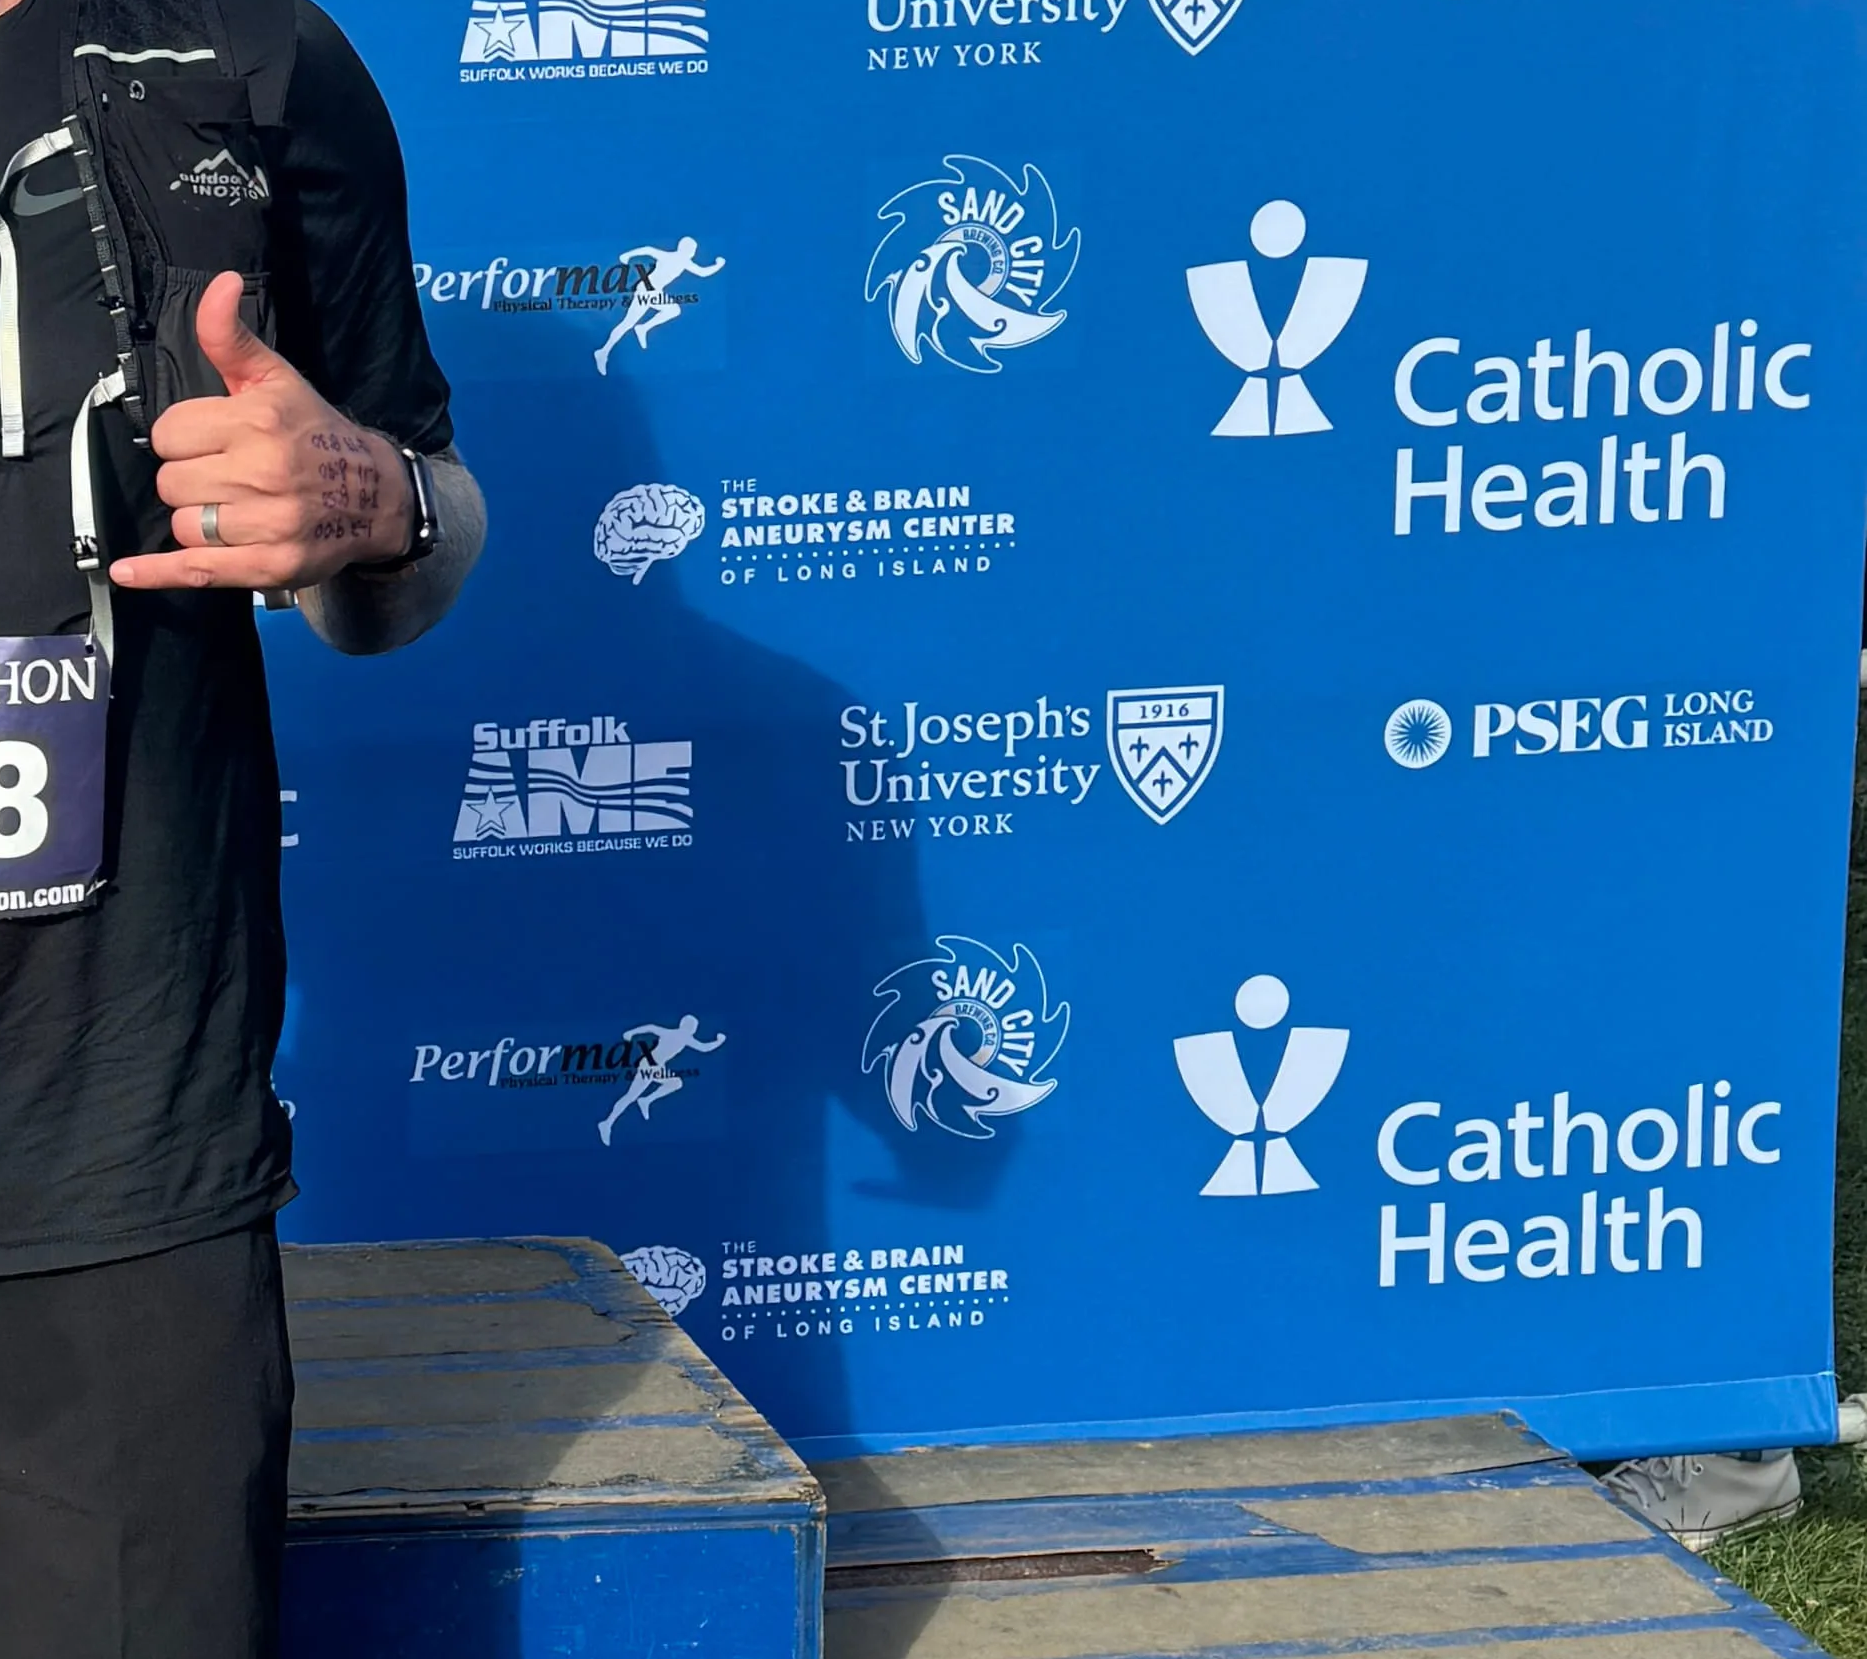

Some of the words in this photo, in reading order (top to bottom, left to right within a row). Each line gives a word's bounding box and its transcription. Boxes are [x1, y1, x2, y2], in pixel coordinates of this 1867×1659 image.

[459, 67, 526, 83] SUFFOLK
[528, 64, 586, 80] WORKS
[588, 61, 656, 78] BECAUSE
[658, 60, 684, 75] WE
[686, 59, 709, 74] DO
[868, 45, 940, 71] NEW
[953, 41, 1041, 67] YORK
[937, 187, 1025, 235] SAND
[1005, 235, 1045, 307] CITY
[1394, 318, 1812, 427] Catholic
[1394, 431, 1726, 536] Health
[1140, 702, 1190, 720] 1916
[1473, 695, 1649, 758] PSEG
[1664, 689, 1754, 717] LONG
[473, 716, 631, 751] Suffolk
[840, 705, 895, 748] St.
[889, 696, 1090, 763] Joseph's
[1663, 719, 1774, 747] ISLAND
[840, 754, 1101, 806] University
[846, 818, 916, 842] NEW
[928, 813, 1013, 837] YORK
[931, 965, 1016, 1010] SAND
[996, 1009, 1035, 1077] CITY
[409, 1037, 659, 1086] Performax
[1377, 1079, 1782, 1186] Catholic
[1379, 1186, 1703, 1287] Health
